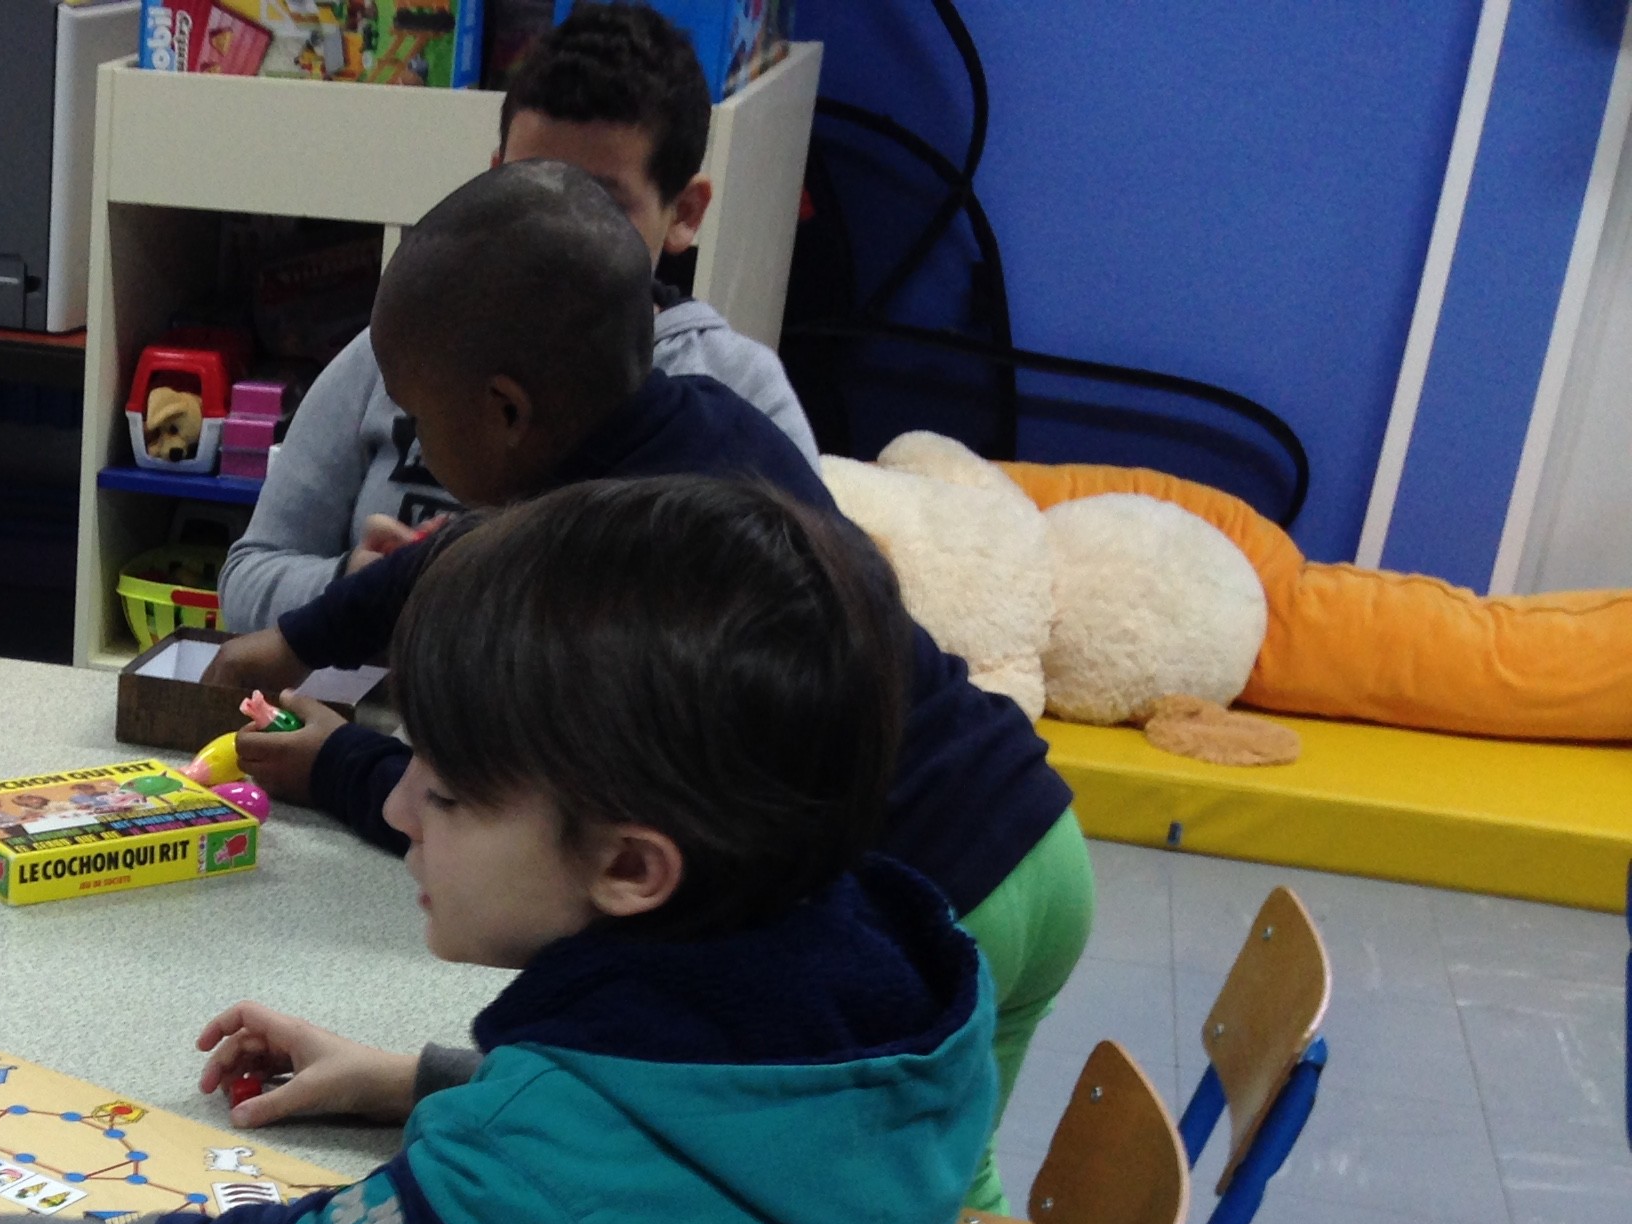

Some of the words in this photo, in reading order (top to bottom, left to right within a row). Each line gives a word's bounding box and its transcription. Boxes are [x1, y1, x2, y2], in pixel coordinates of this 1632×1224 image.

[69, 768, 114, 781] QUI
[113, 762, 157, 776] RIT
[19, 863, 39, 884] LE
[42, 850, 119, 881] COCHON
[122, 845, 155, 870] QUI
[159, 840, 190, 862] RIT
